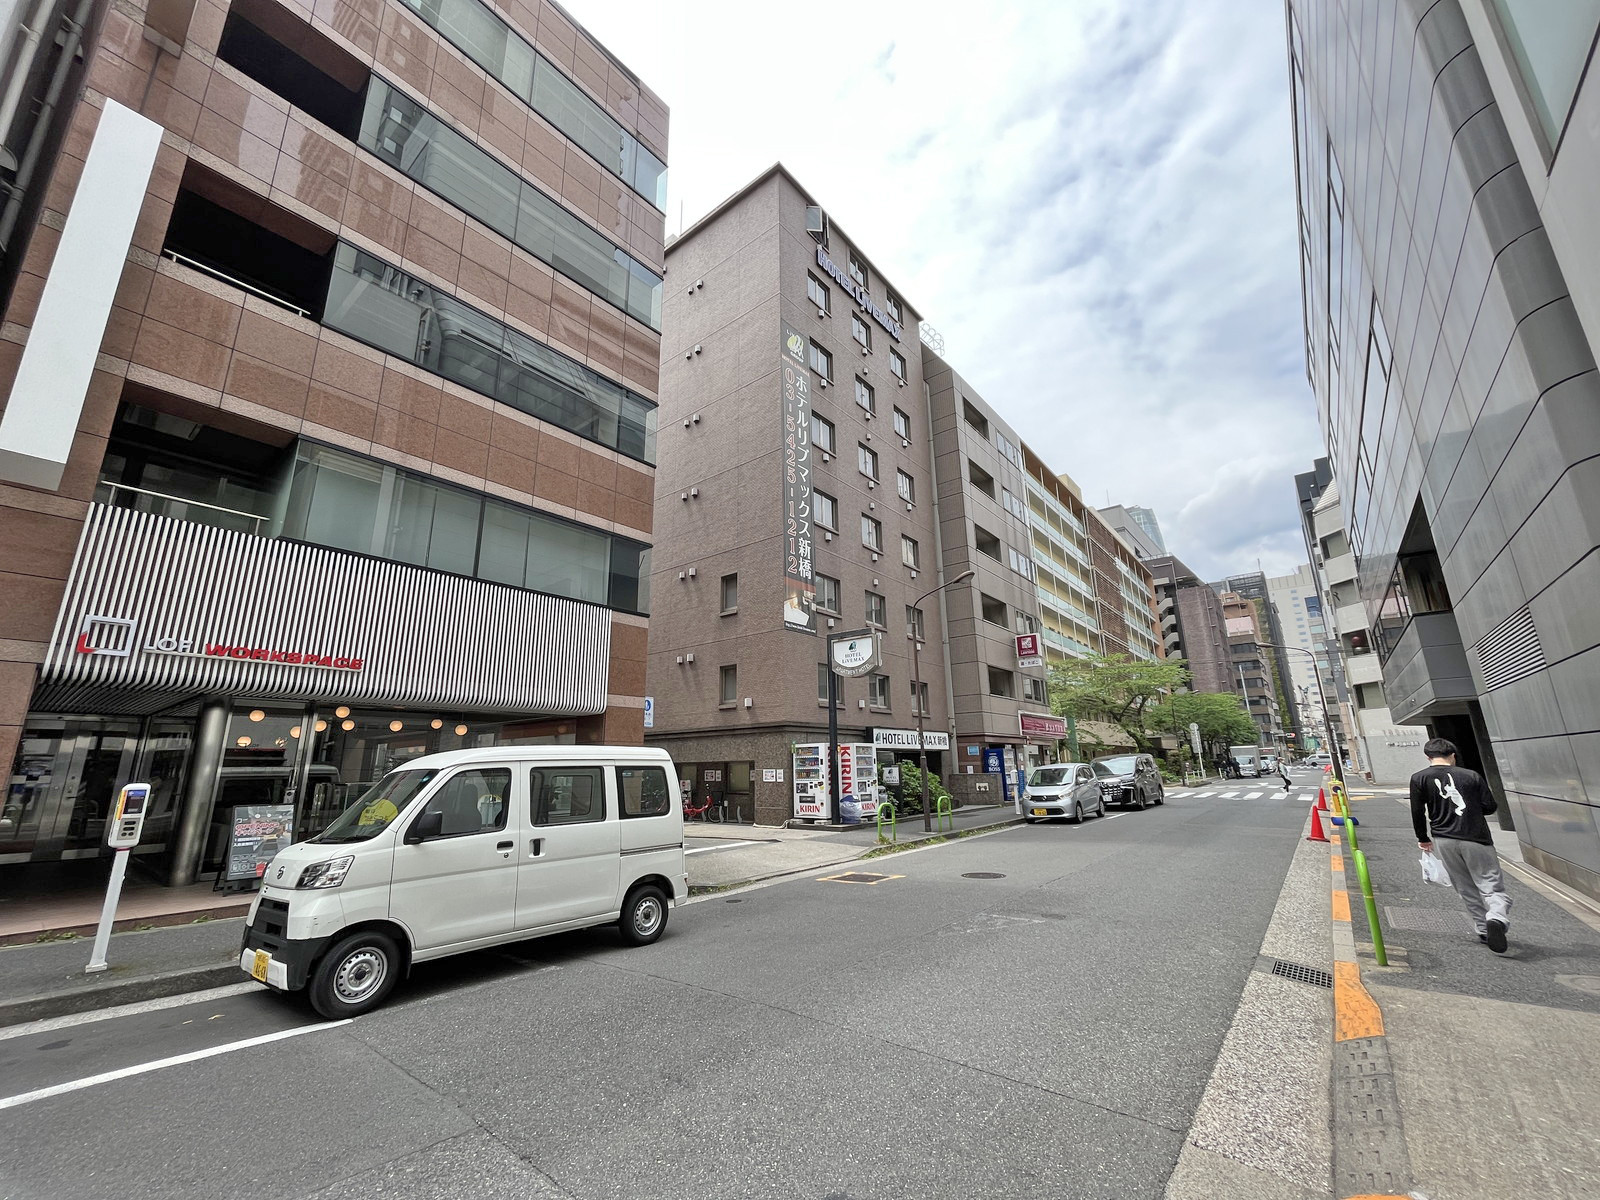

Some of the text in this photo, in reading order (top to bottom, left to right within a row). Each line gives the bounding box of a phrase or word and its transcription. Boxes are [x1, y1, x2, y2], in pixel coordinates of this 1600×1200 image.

[817, 248, 856, 299] HOTEL
[784, 367, 798, 575] 03-5425-1212
[796, 375, 812, 580] ホテルリブマックス新橋
[143, 637, 364, 670] LOF WORKSPACE
[882, 732, 906, 745] HOTEL
[840, 746, 852, 794] KIRIN
[800, 805, 821, 813] KIRIN
[861, 802, 876, 811] KIRIN
